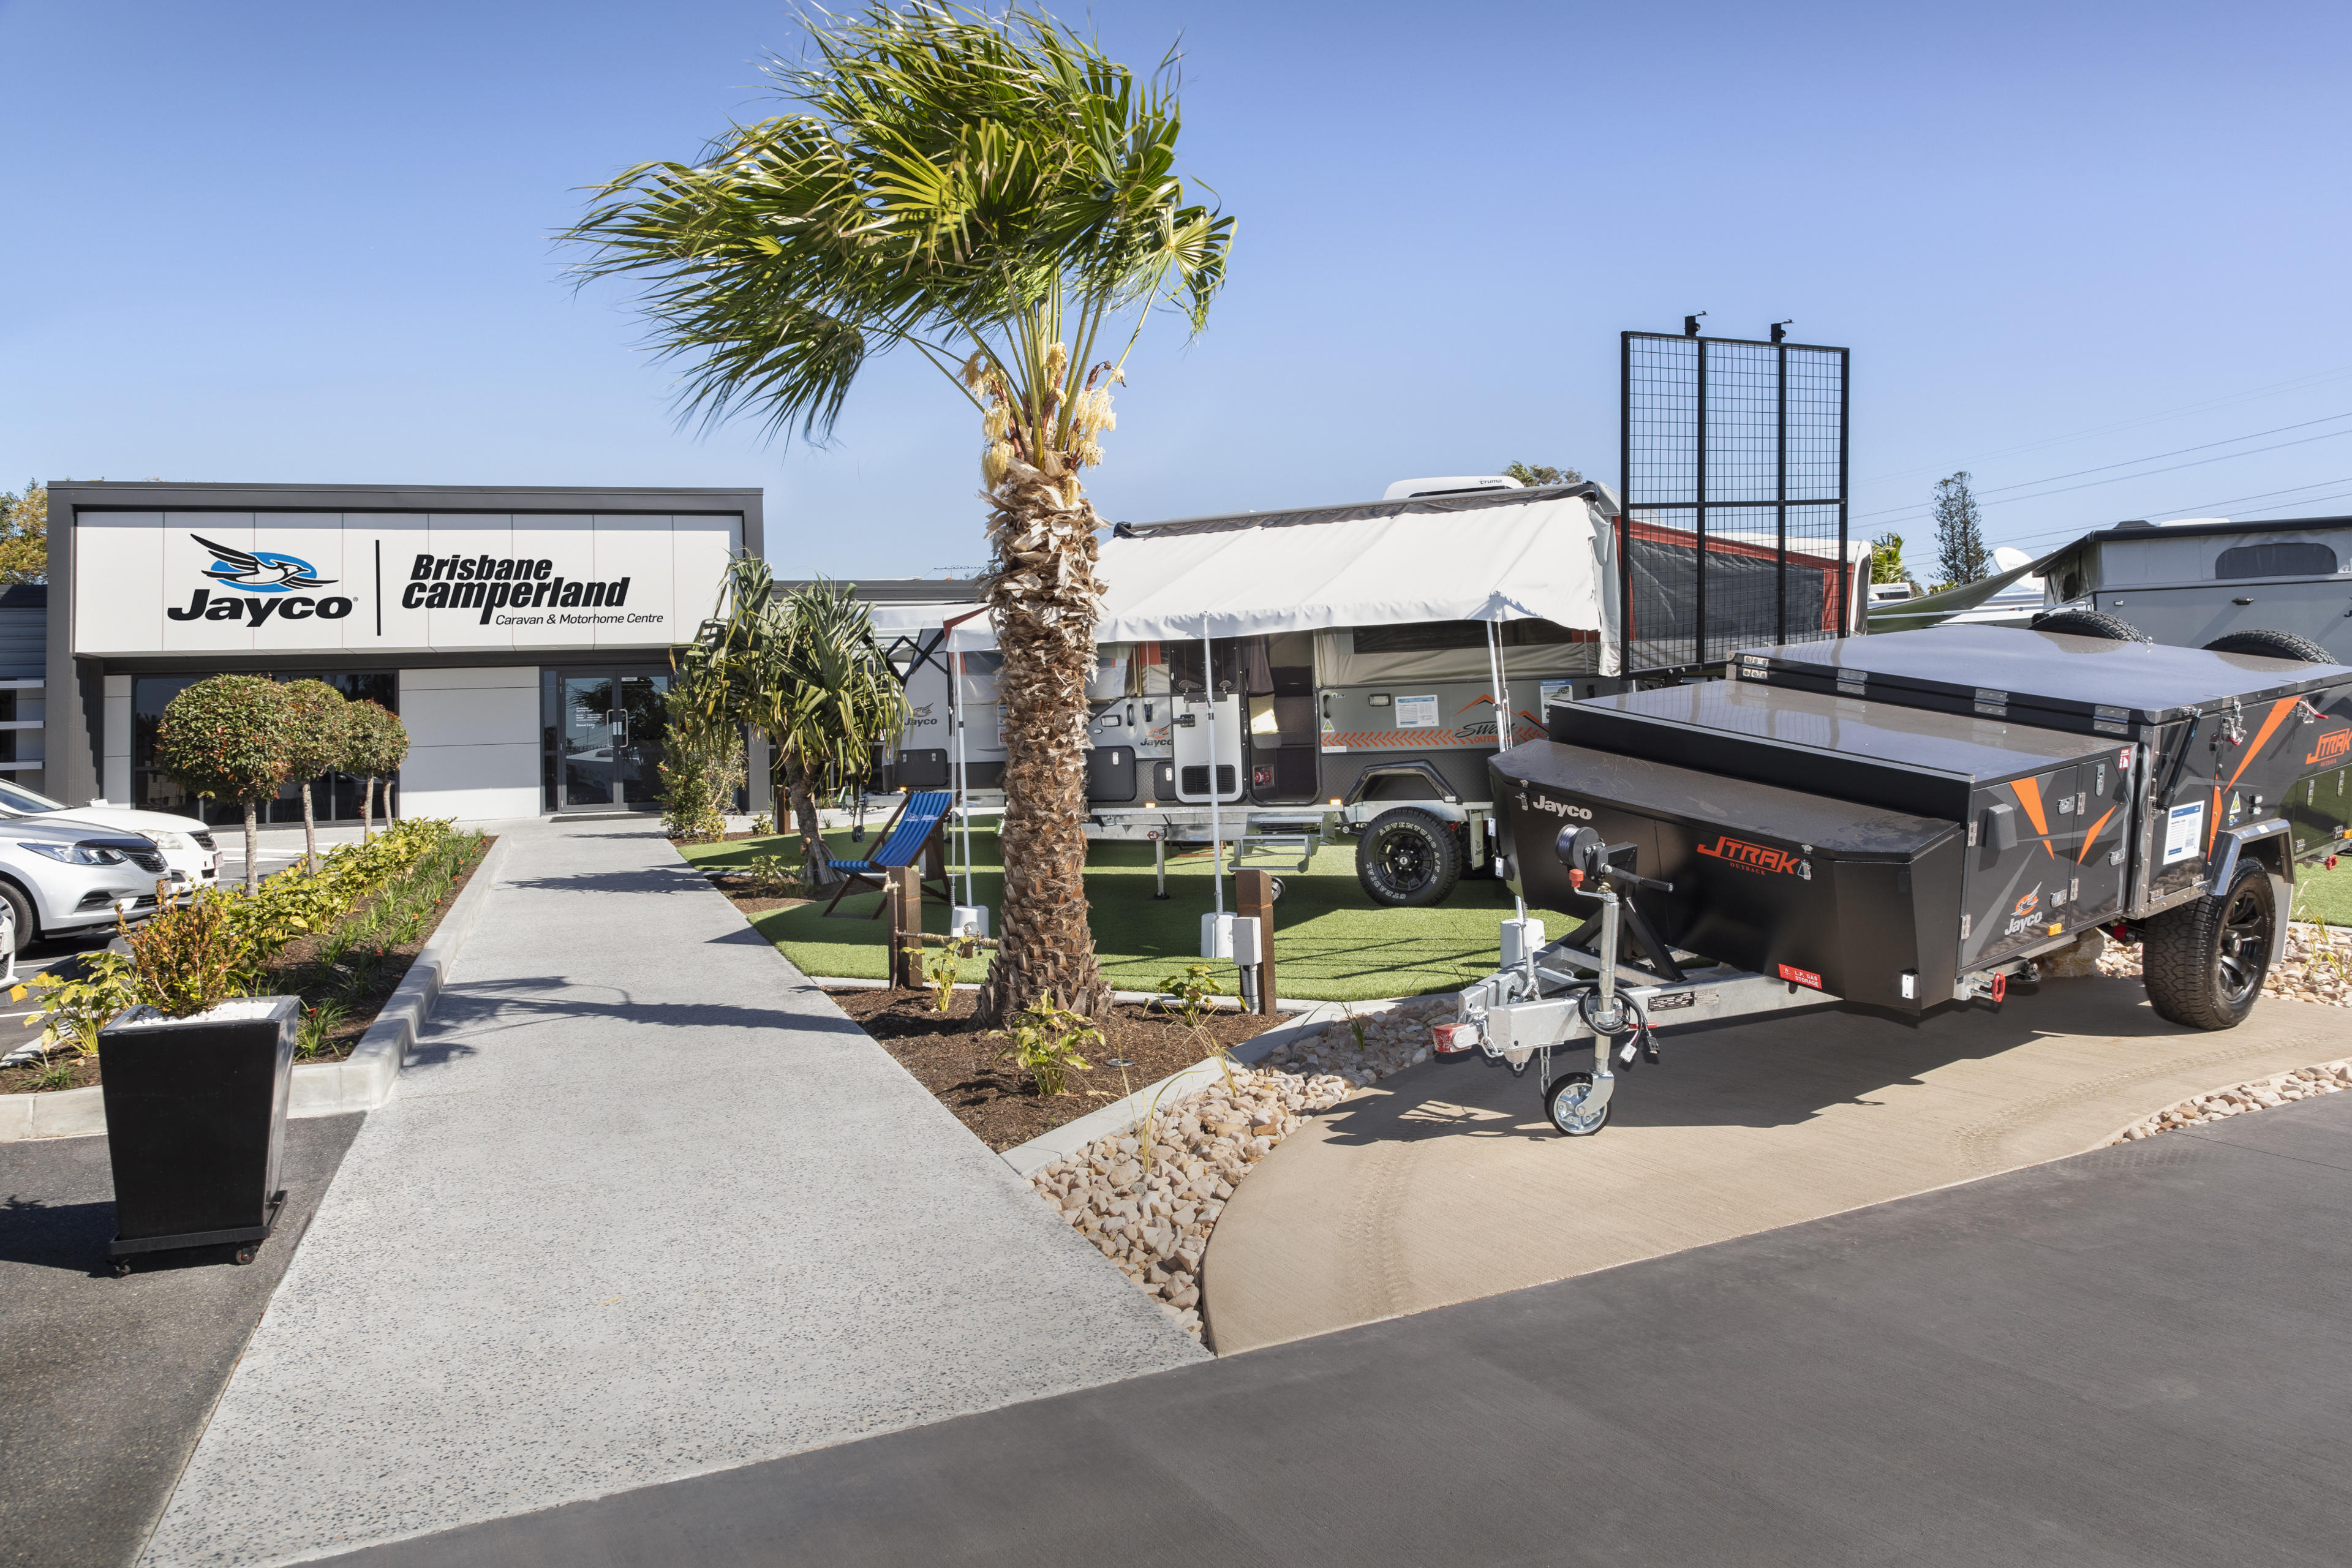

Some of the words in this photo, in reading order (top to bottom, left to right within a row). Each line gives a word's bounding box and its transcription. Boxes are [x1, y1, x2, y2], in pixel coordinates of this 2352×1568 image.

[410, 554, 552, 581] Brisbane
[167, 589, 353, 627] Jayco
[402, 577, 631, 625] camperland
[496, 614, 543, 625] Caravan
[546, 614, 556, 624] &
[559, 613, 624, 624] Motorhome
[627, 613, 663, 624] Centre
[905, 717, 938, 727] Jayco
[1140, 737, 1172, 747] Jayco
[1532, 795, 1593, 820] Jayco
[1379, 822, 1436, 848] ADVENTURO
[1730, 861, 1766, 876] OUTBACK
[2004, 911, 2043, 935] Jayco
[1795, 976, 1819, 987] STORAGE
